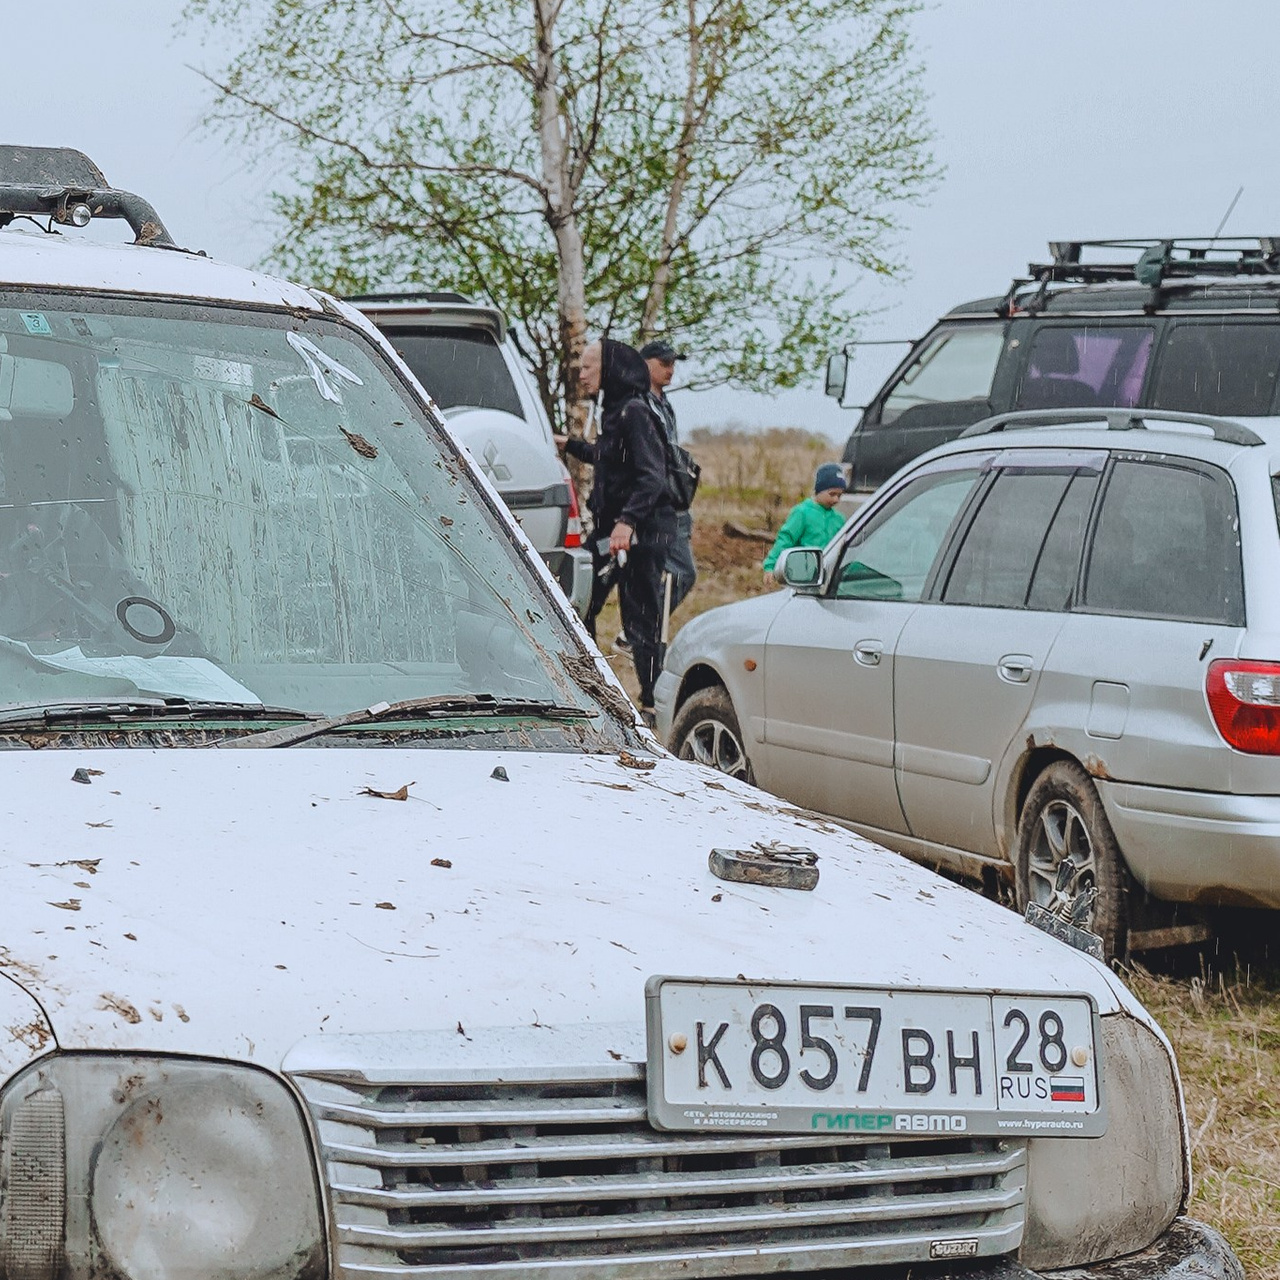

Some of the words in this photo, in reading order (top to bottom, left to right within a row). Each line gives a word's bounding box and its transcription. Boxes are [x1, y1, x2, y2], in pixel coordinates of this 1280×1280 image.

[1002, 1008, 1068, 1074] 28
[1000, 1076, 1048, 1100] RUS
[997, 1119, 1084, 1130] www.hyperauto.ru
